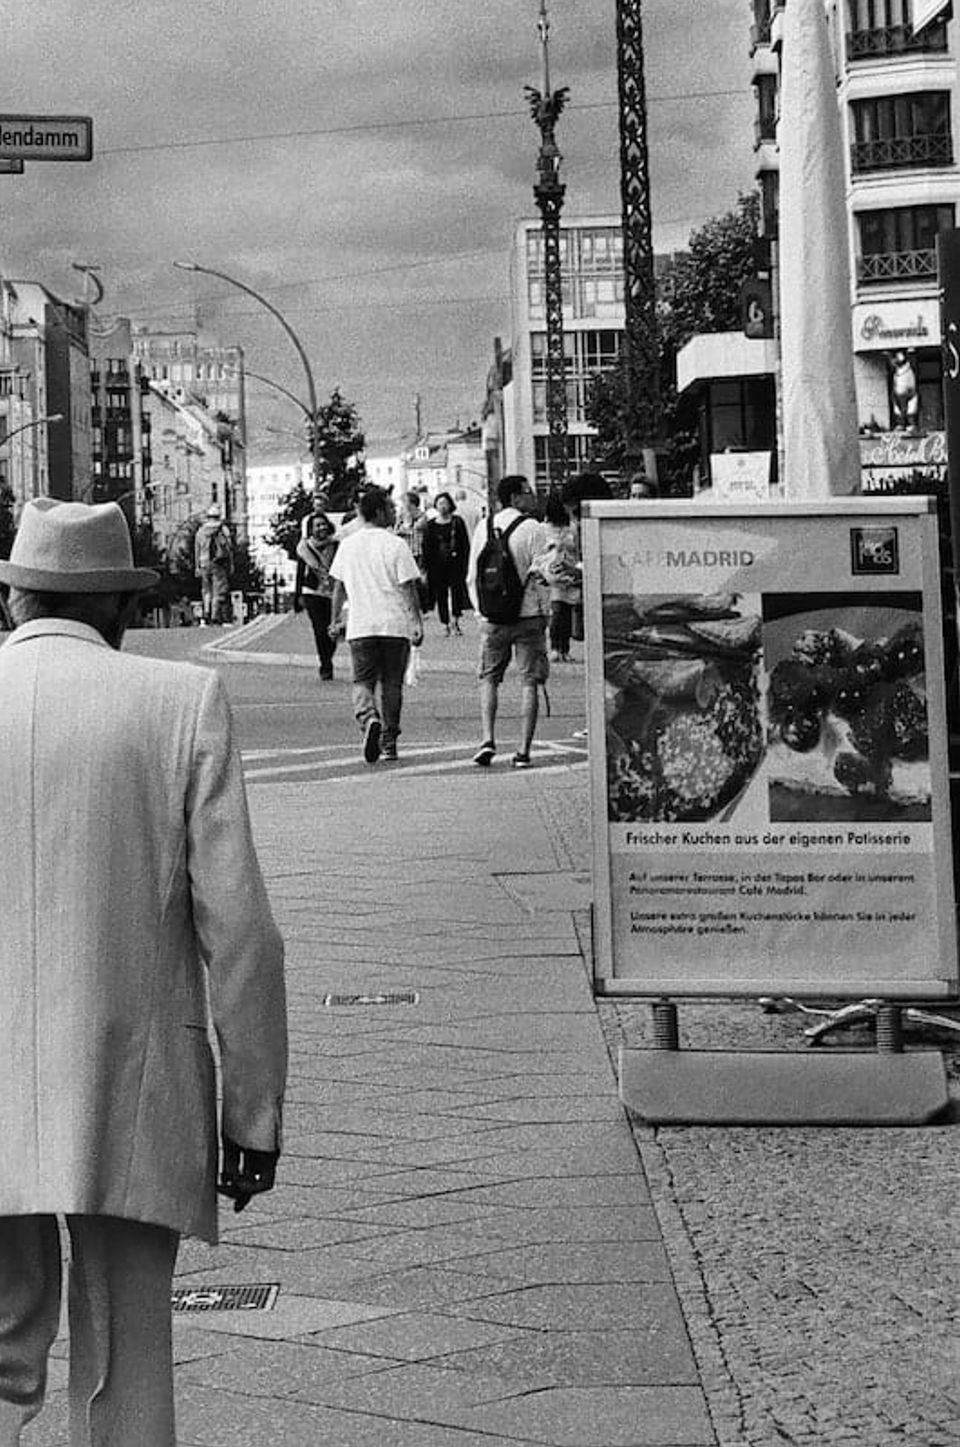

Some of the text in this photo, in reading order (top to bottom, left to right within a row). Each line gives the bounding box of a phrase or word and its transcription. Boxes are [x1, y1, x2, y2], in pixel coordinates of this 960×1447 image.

[666, 550, 755, 567] MADRID
[626, 831, 678, 845] Frischer
[682, 831, 731, 845] Kuchen
[735, 834, 759, 845] aus
[762, 832, 785, 845] der
[789, 831, 843, 848] eigenen
